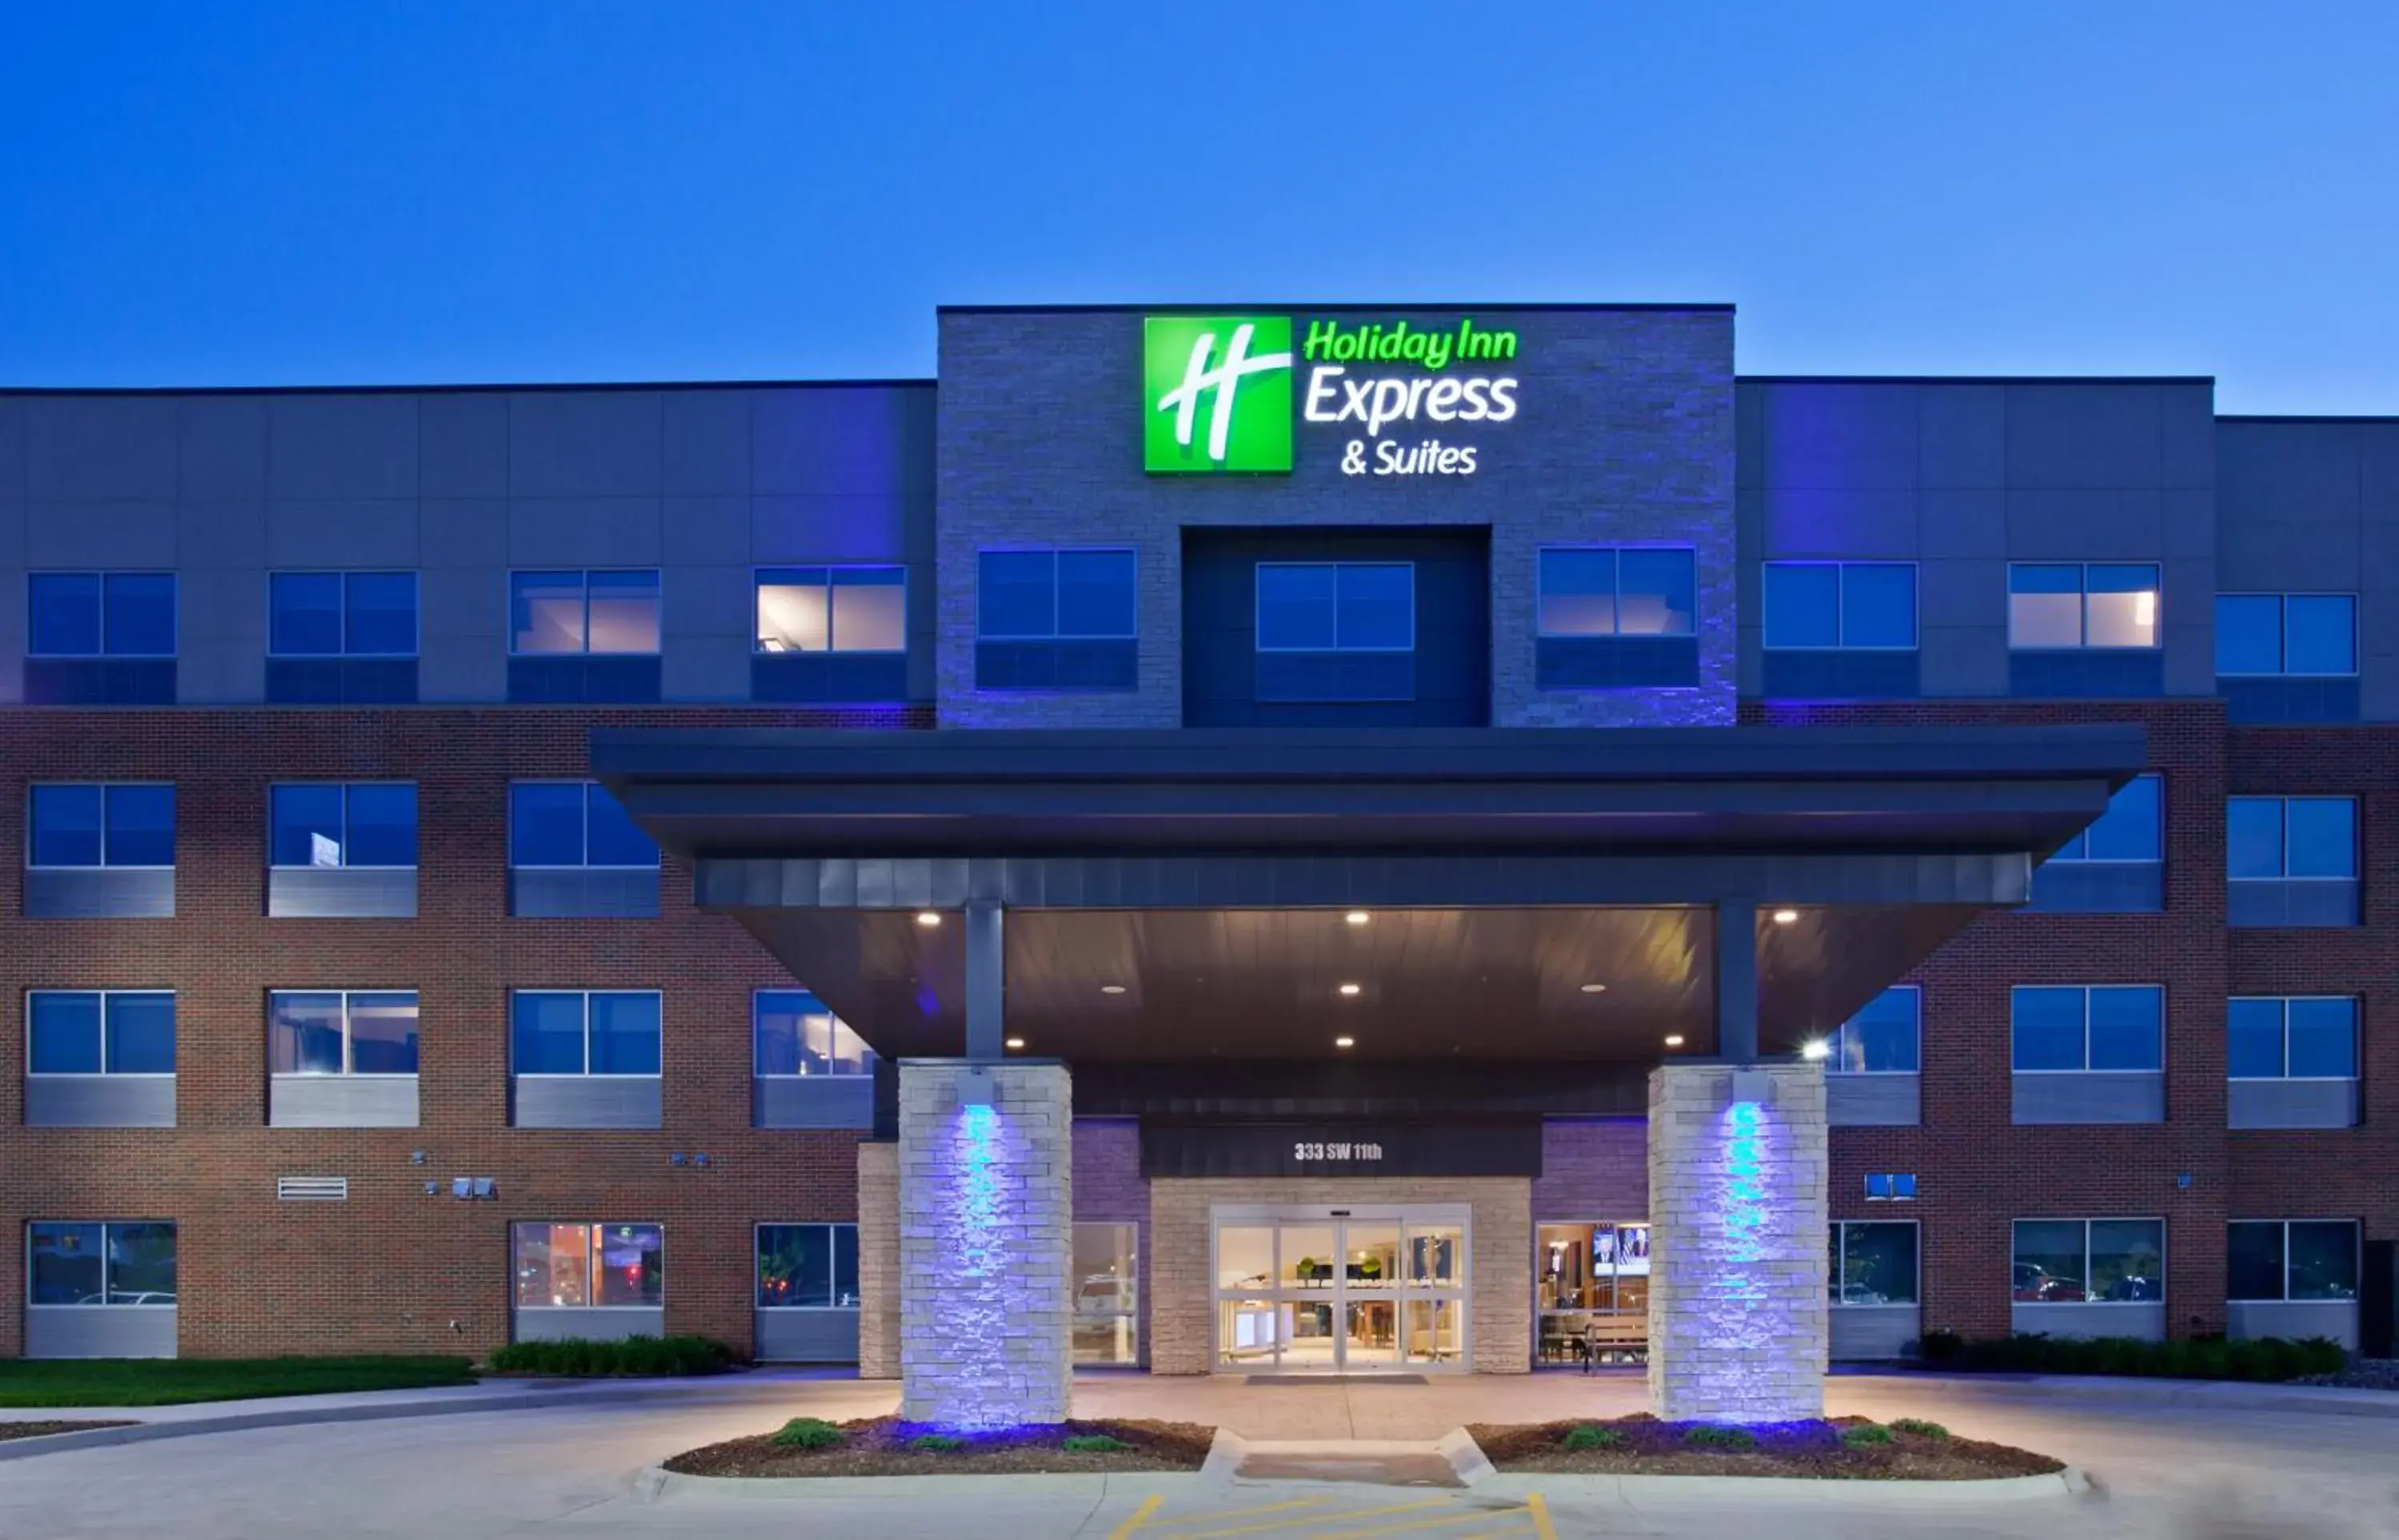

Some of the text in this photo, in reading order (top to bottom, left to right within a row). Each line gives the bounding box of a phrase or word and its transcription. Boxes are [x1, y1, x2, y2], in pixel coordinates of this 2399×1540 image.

[1304, 320, 1517, 369] Holiday Inn
[1304, 366, 1519, 437] Express
[1341, 440, 1478, 476] & Suites
[1295, 1143, 1383, 1160] 333 SW 11th
